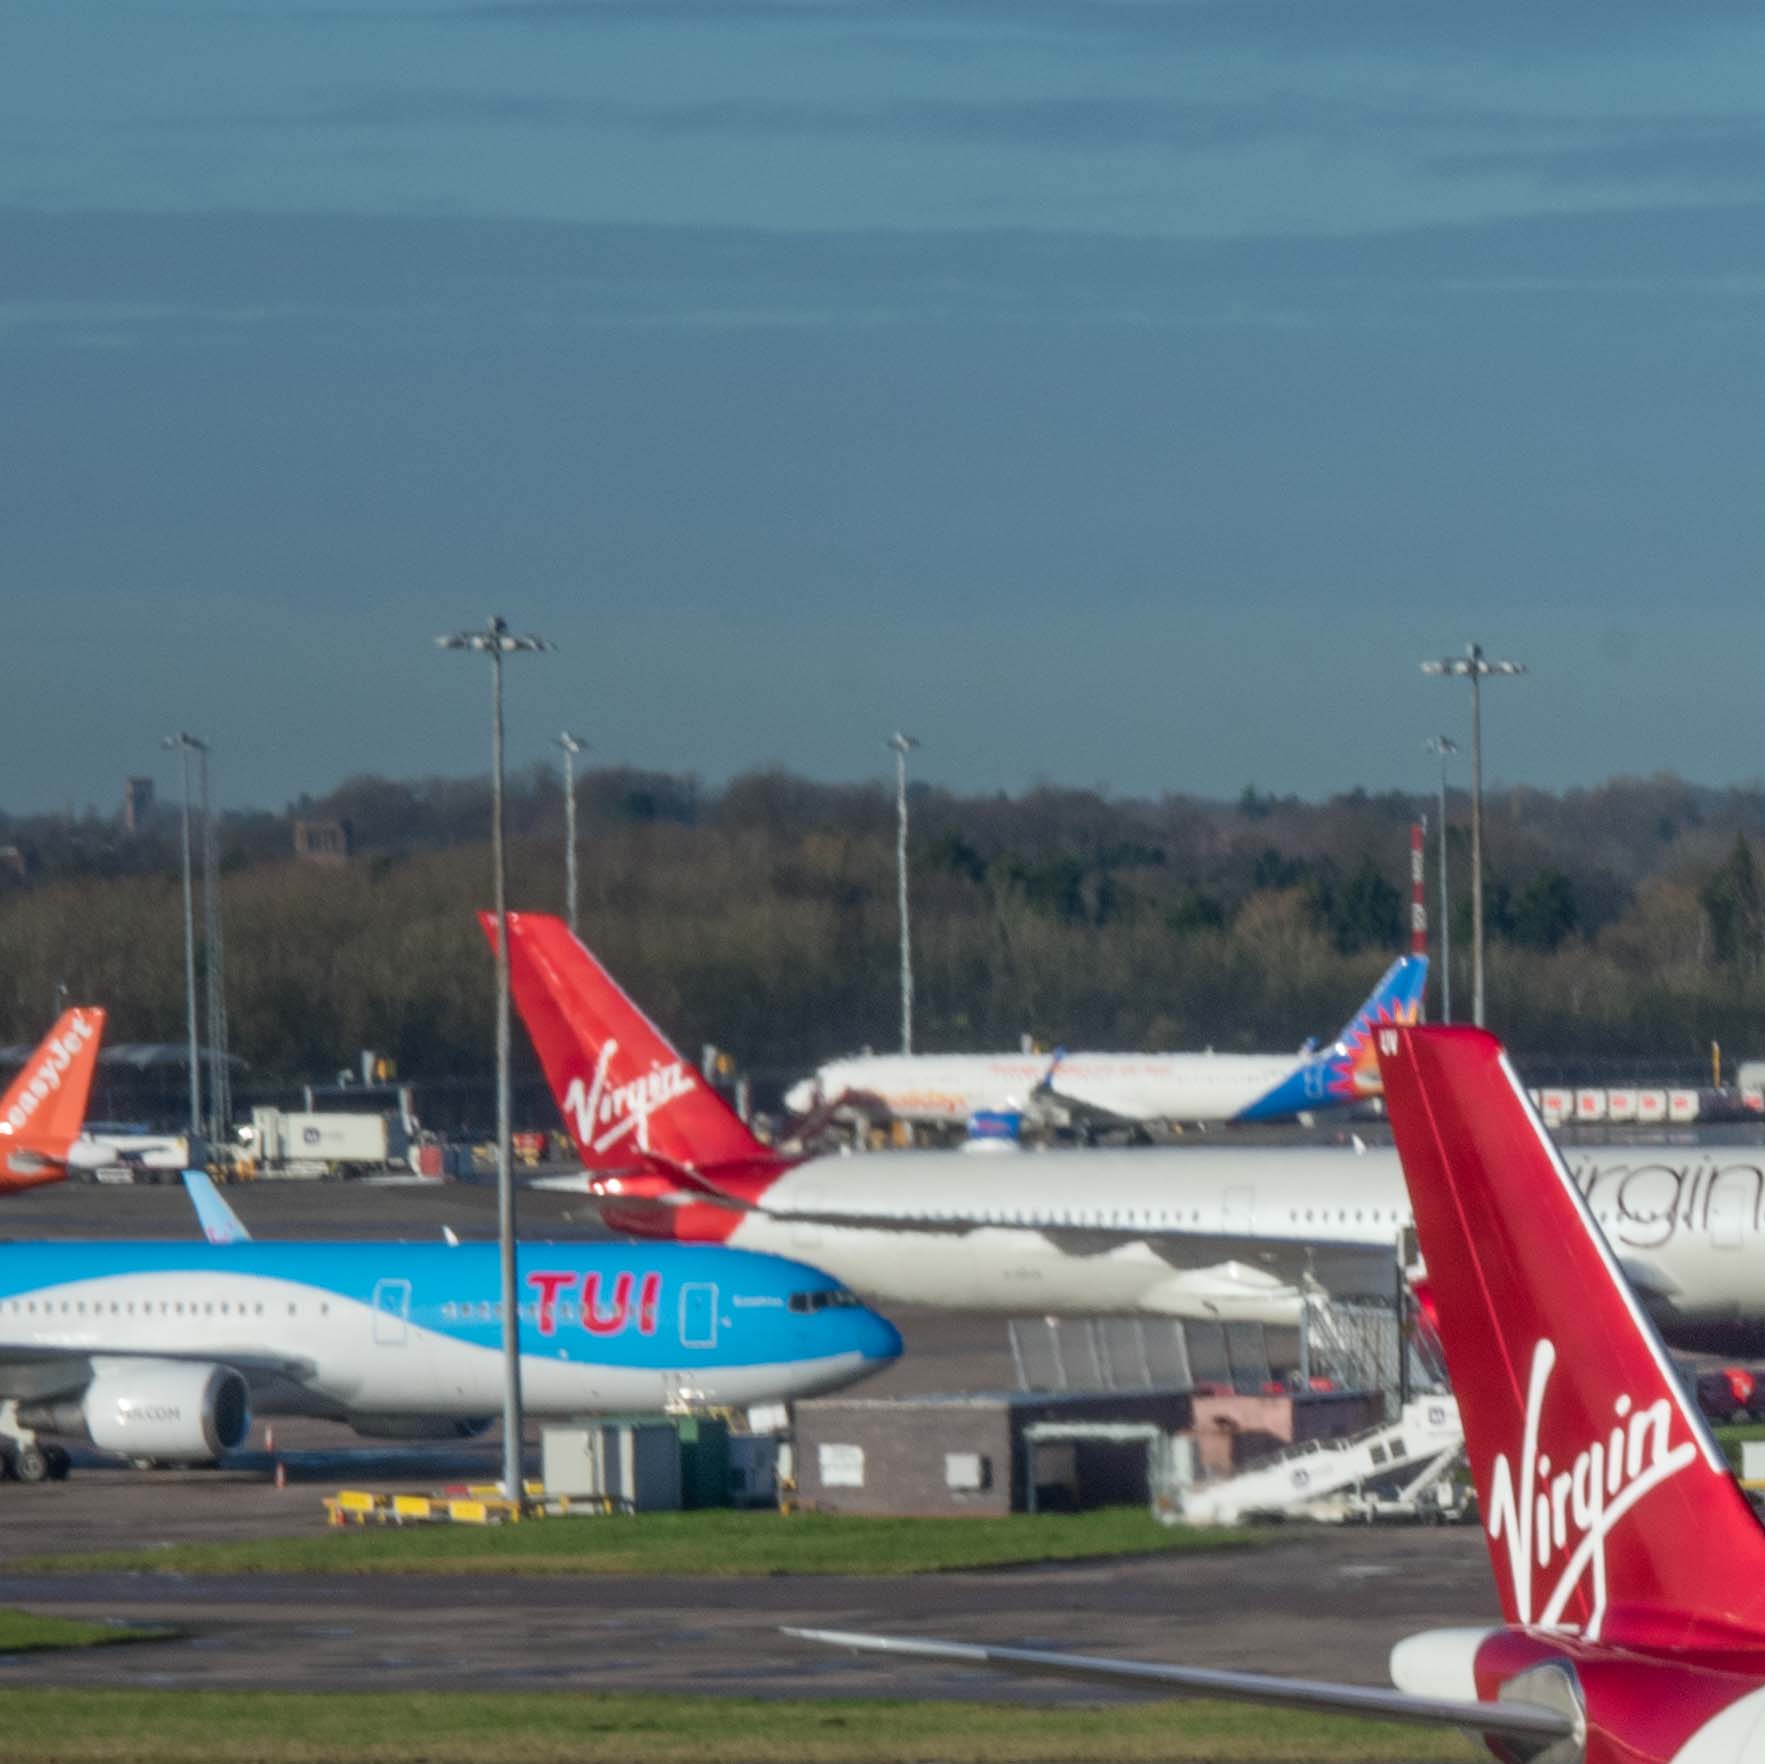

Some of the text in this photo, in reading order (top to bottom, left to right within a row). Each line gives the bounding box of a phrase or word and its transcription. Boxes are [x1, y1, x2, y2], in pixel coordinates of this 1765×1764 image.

[562, 1038, 695, 1154] Virgin
[528, 1271, 662, 1336] TUI
[1489, 1338, 1696, 1643] Virgin
